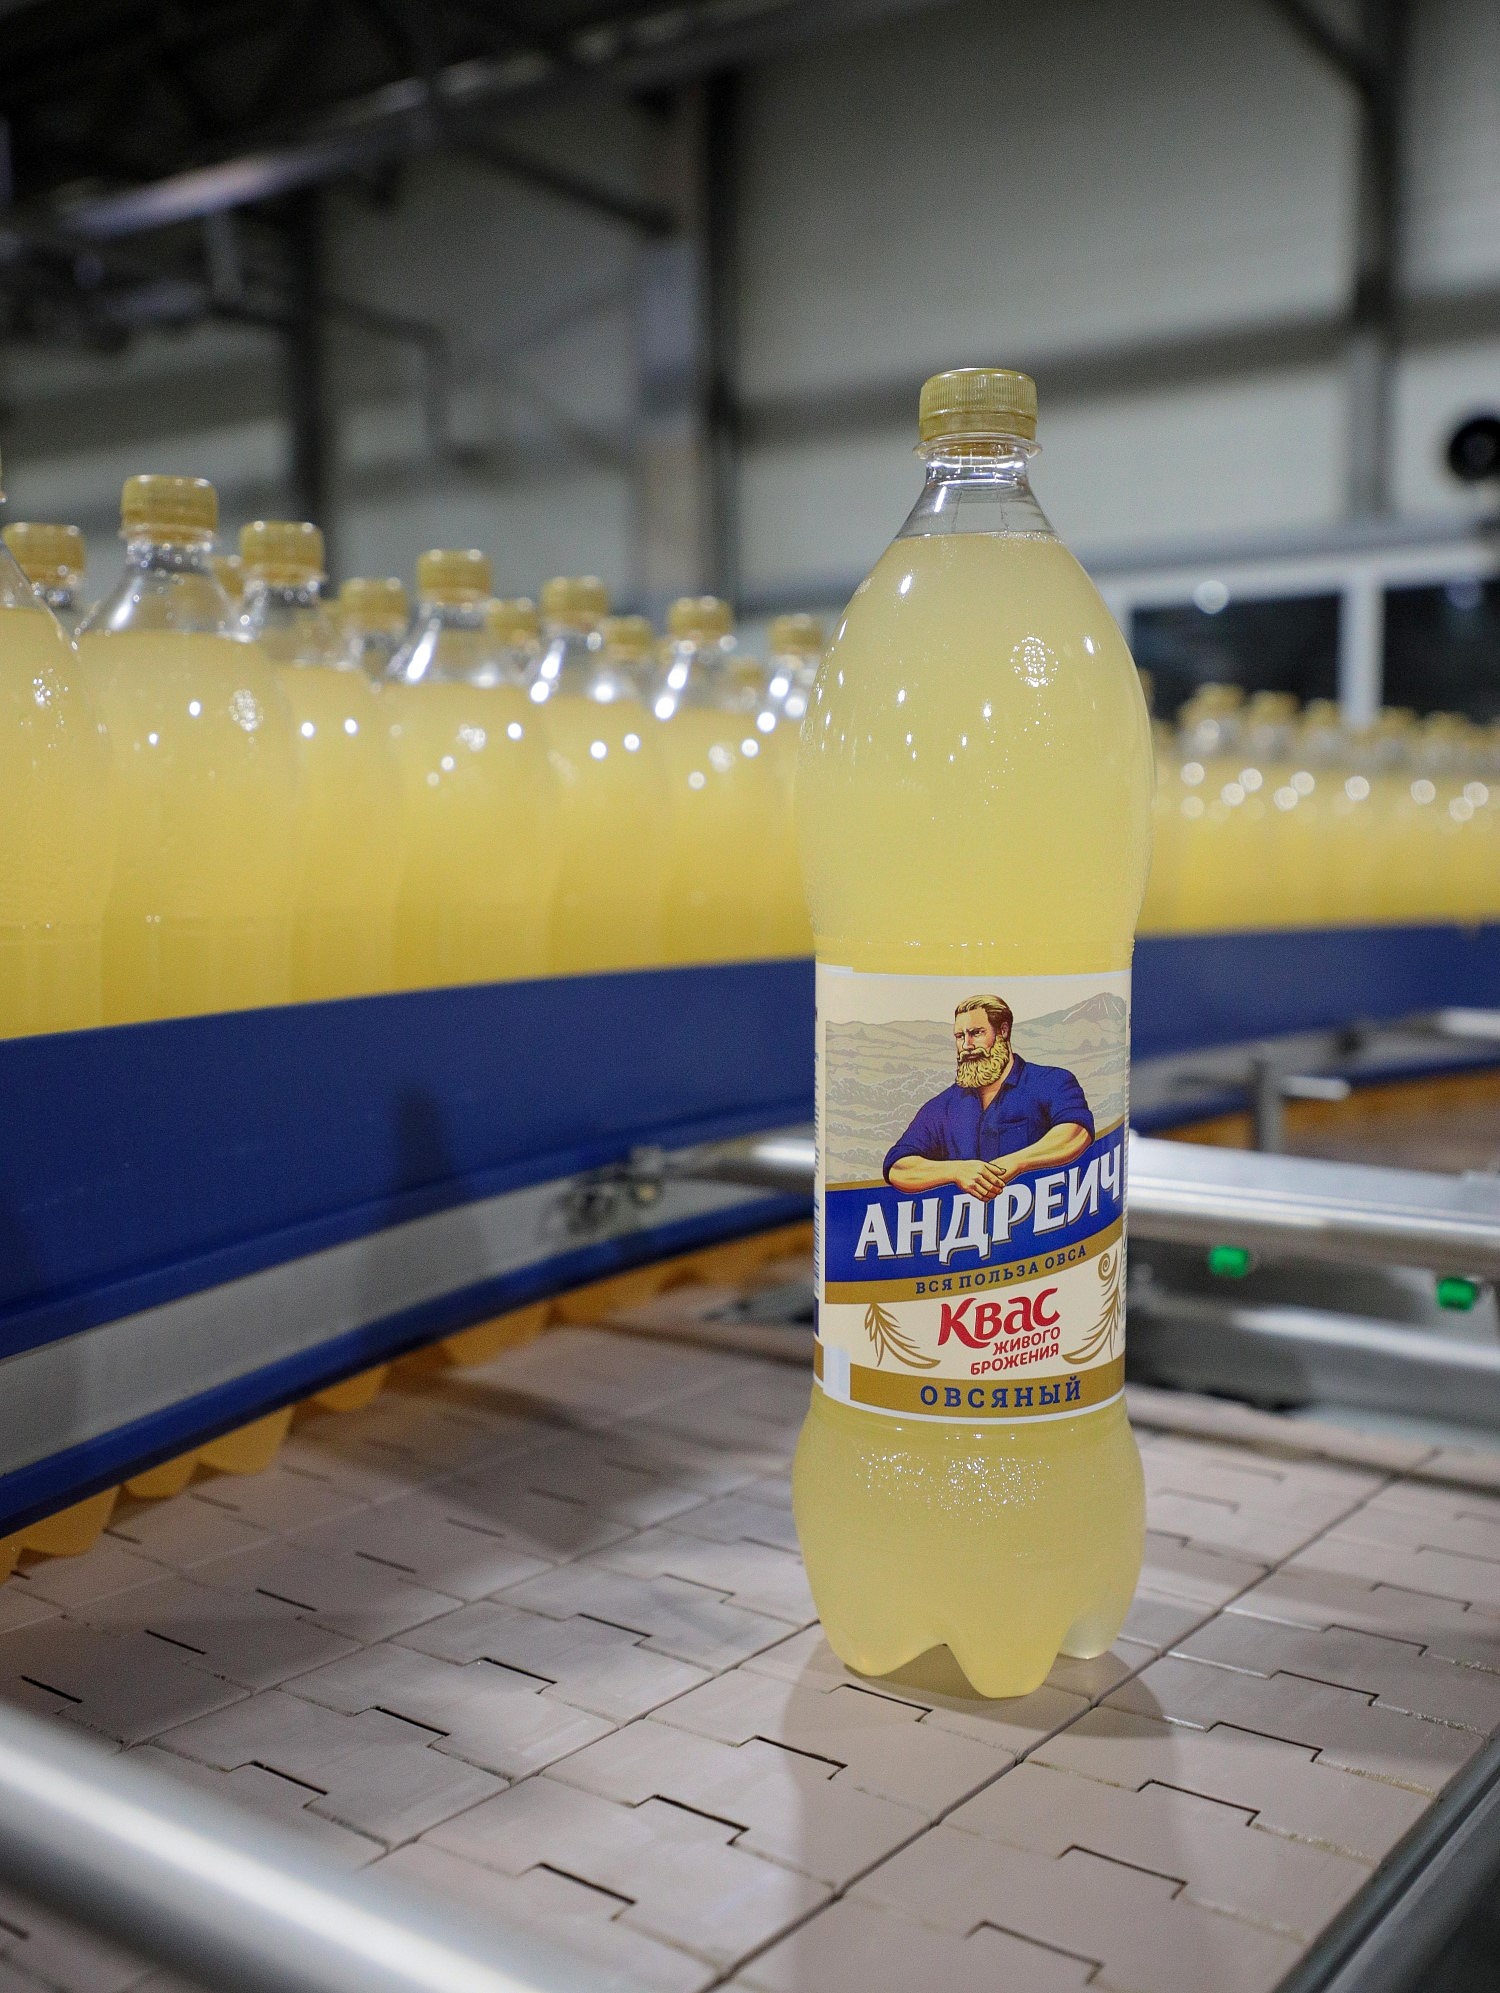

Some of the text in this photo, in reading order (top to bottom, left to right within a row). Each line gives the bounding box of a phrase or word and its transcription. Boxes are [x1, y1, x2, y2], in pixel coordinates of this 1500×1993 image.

[854, 1144, 1121, 1266] АНДРЕИЧ
[916, 1244, 1087, 1294] ВСЯ ПОЛЬЗА ОВСА
[993, 1327, 1061, 1356] ЖИВОГО
[969, 1343, 1059, 1376] БРОЖЕНИЯ
[920, 1376, 1082, 1408] ОВСЯНЫЙ
